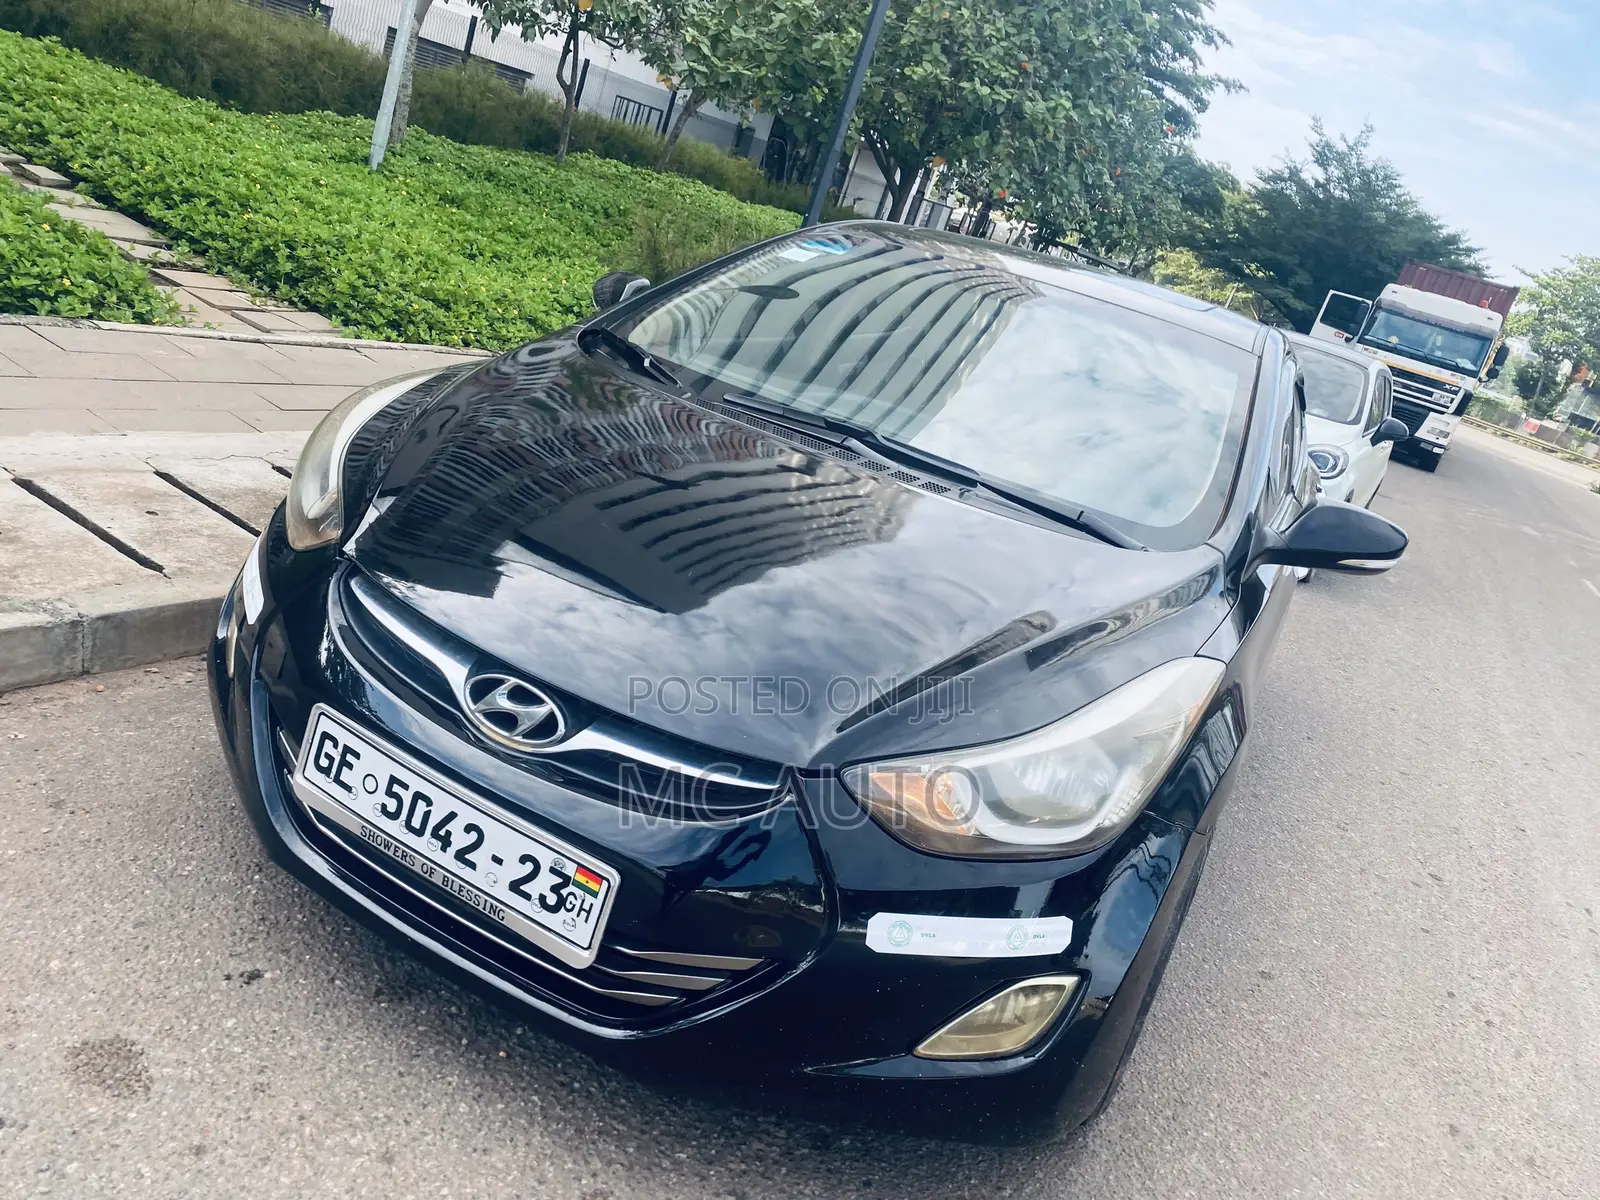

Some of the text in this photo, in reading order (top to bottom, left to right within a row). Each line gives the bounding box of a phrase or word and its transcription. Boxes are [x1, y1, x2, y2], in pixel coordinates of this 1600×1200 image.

[314, 731, 361, 793] GE
[360, 826, 506, 922] SHOWERS OF BLESSING
[564, 892, 593, 924] GH
